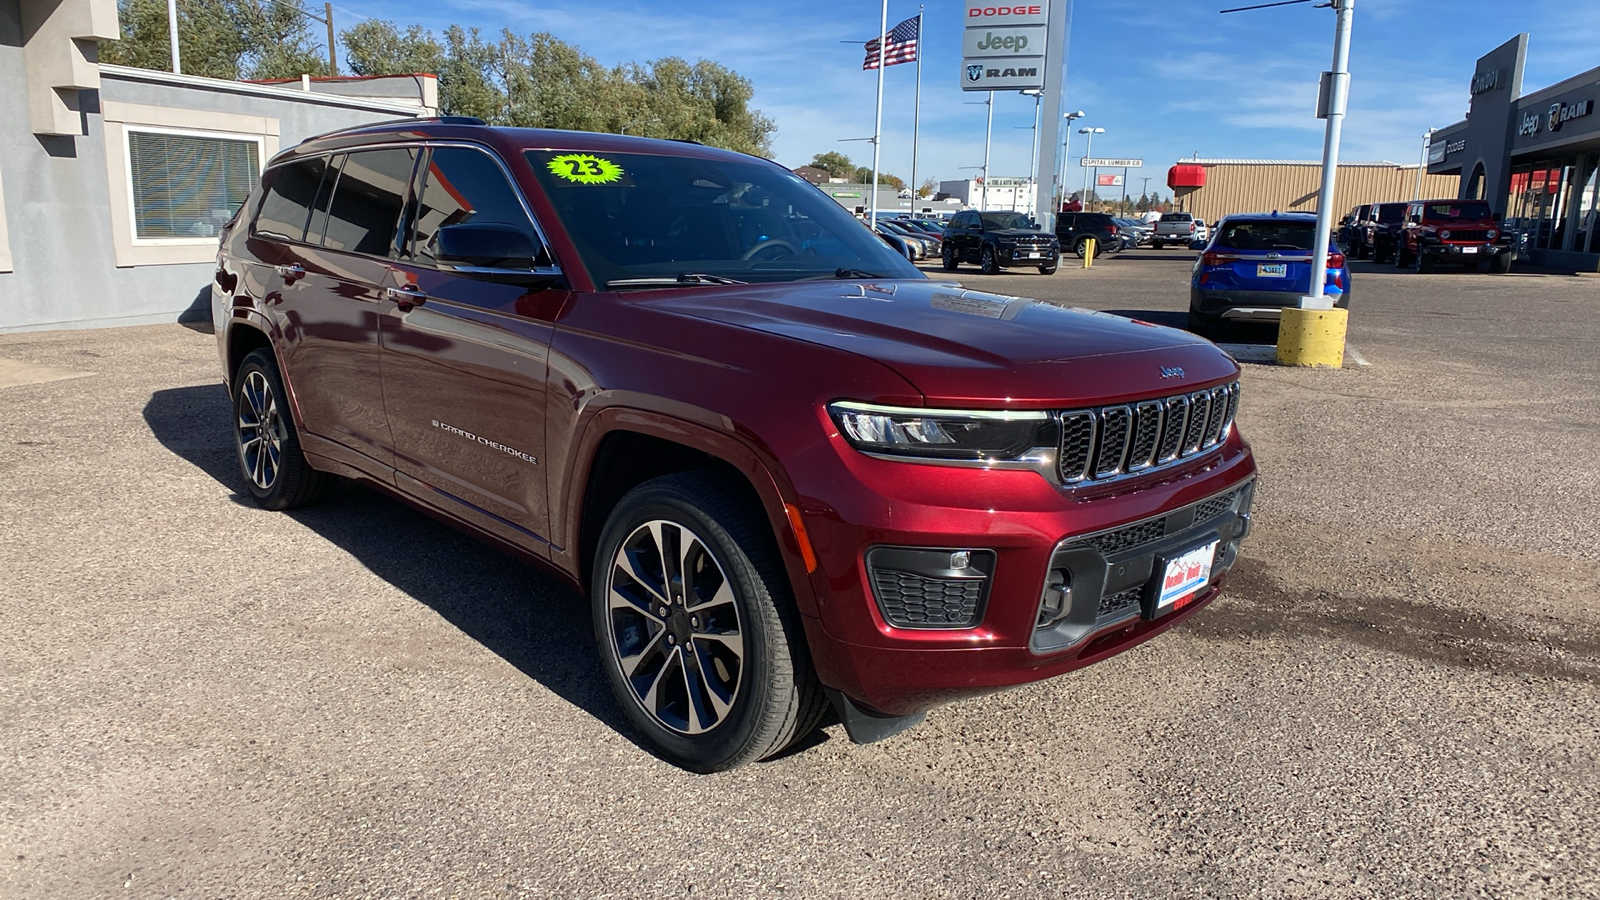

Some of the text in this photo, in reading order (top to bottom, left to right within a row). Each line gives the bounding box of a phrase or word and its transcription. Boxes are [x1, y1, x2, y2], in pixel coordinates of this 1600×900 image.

[969, 6, 1041, 17] DODGE
[977, 32, 1028, 52] Jeep
[986, 68, 1037, 77] RAM
[1471, 68, 1499, 95] Cowboy
[1560, 101, 1588, 121] RAM
[1519, 112, 1539, 137] Jeep
[1446, 139, 1466, 154] DODGE
[564, 160, 604, 176] 23
[1160, 366, 1185, 378] Jeep
[441, 422, 537, 465] GRAND CHEROKEE
